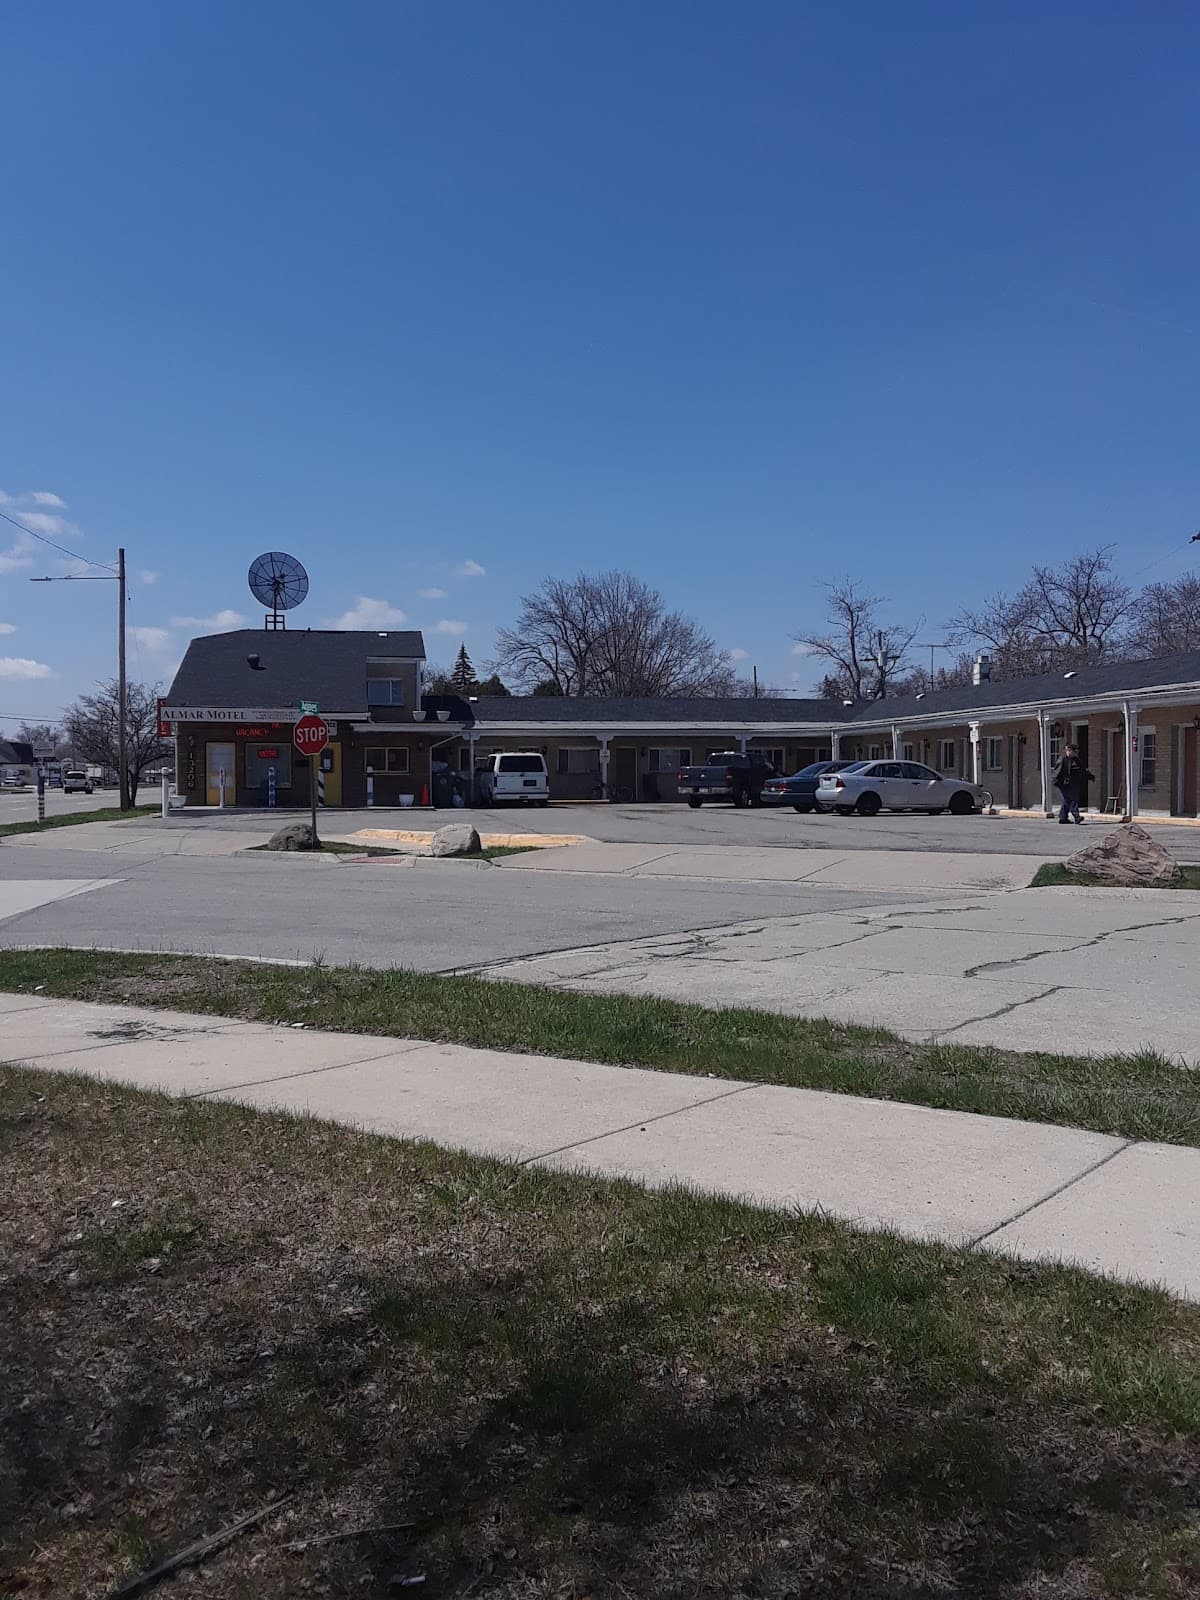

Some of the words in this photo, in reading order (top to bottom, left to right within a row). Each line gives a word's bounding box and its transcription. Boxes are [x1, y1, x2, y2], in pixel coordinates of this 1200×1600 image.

[207, 710, 248, 720] MOTEL
[235, 728, 270, 737] VACANCY
[296, 727, 326, 743] STOP
